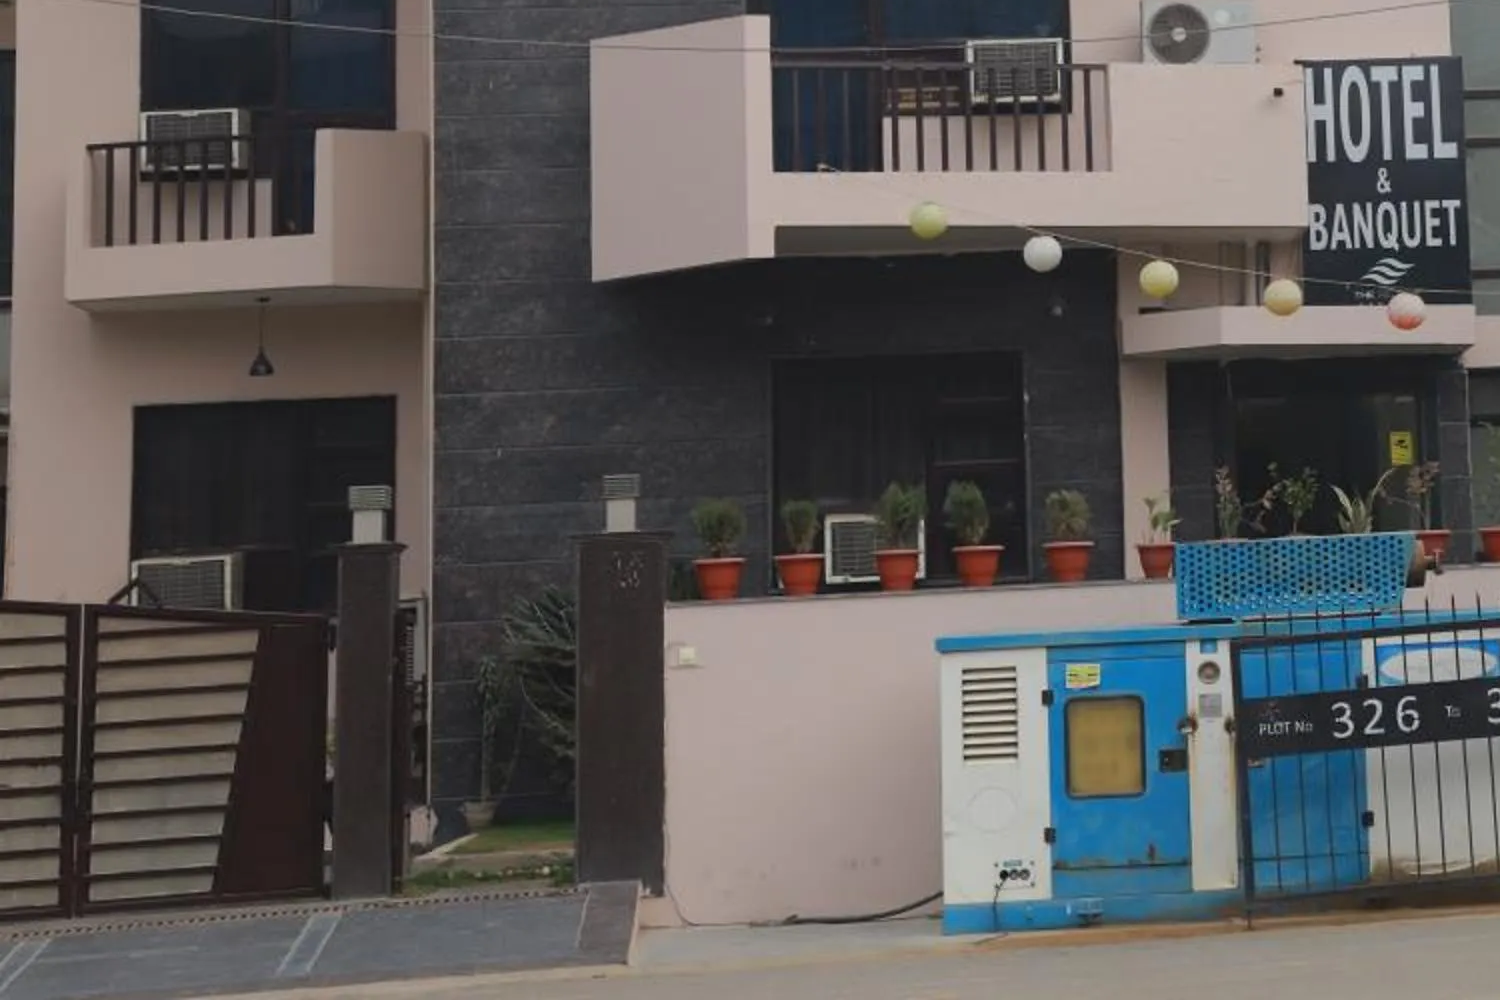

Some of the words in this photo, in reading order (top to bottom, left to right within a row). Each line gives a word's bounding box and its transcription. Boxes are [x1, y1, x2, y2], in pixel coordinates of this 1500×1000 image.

[1304, 64, 1459, 163] HOTEL
[1376, 167, 1392, 193] &
[1308, 199, 1461, 251] BANQUET
[1259, 722, 1291, 735] PLOT
[1331, 695, 1420, 739] 326
